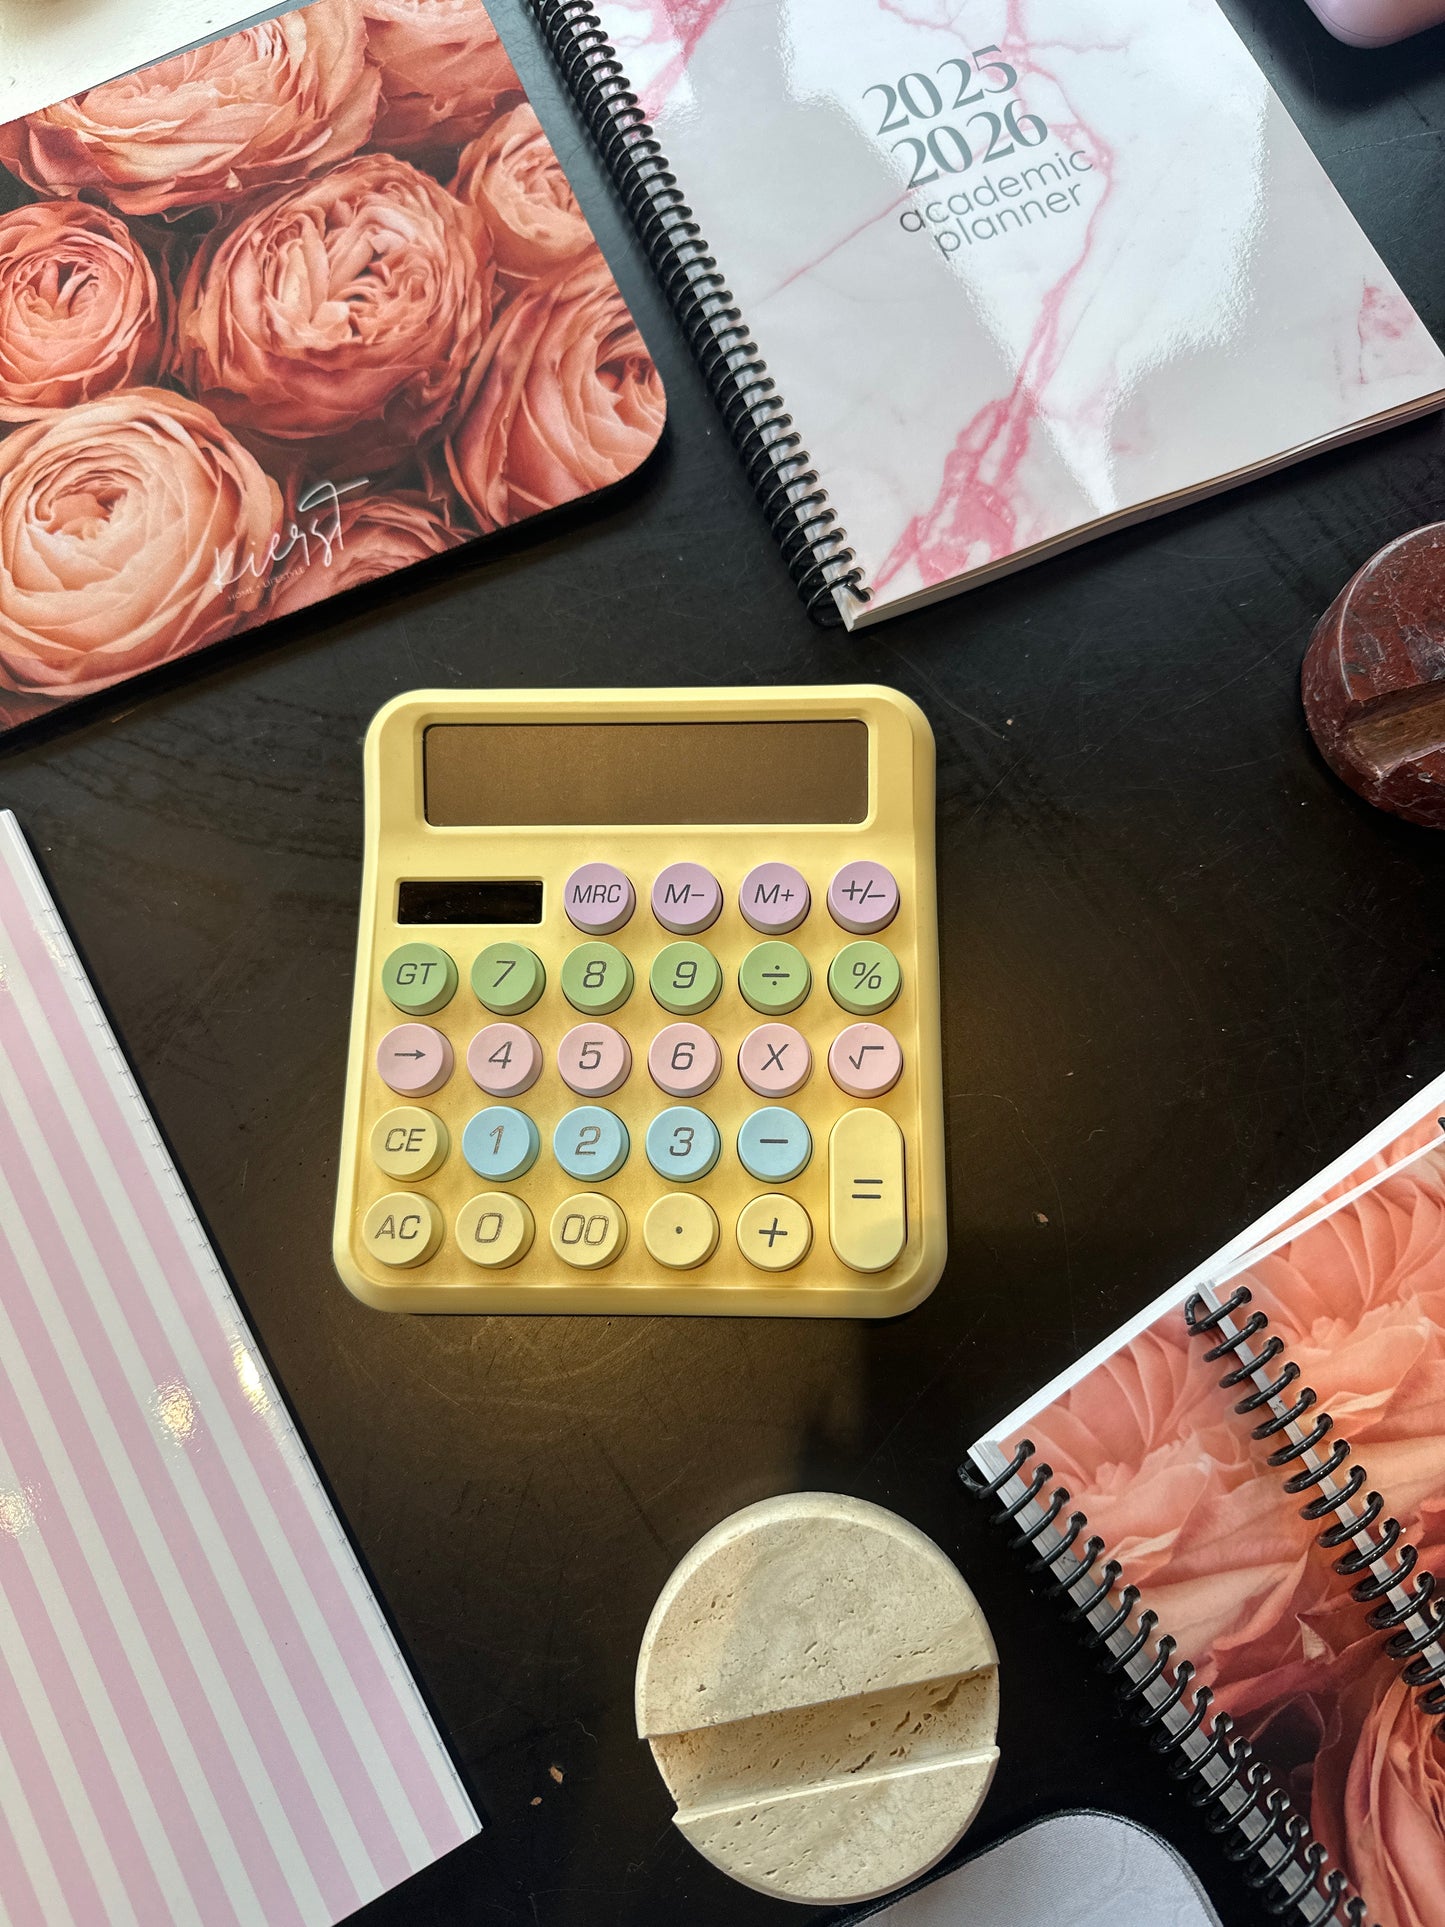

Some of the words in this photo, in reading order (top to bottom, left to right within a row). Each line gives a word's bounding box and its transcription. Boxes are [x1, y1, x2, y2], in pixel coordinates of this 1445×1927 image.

[862, 44, 1018, 136] 2025
[890, 99, 1048, 191] 2026
[899, 150, 1093, 233] academic
[934, 183, 1083, 261] planner
[572, 884, 622, 904] MRC
[754, 884, 794, 904] M+
[396, 963, 437, 985] GT
[493, 961, 516, 987] 7
[583, 961, 607, 988] 8
[673, 961, 697, 988] 9
[853, 962, 881, 989] %
[488, 1041, 512, 1069] 4
[579, 1042, 603, 1069] 5
[671, 1042, 695, 1070] 6
[385, 1128, 426, 1152] CE
[489, 1125, 505, 1155] 1
[575, 1126, 600, 1155] 2
[669, 1127, 694, 1156] 3
[852, 1179, 883, 1199] =
[374, 1215, 421, 1239] AC
[475, 1213, 504, 1243] 0
[560, 1214, 609, 1246] 00
